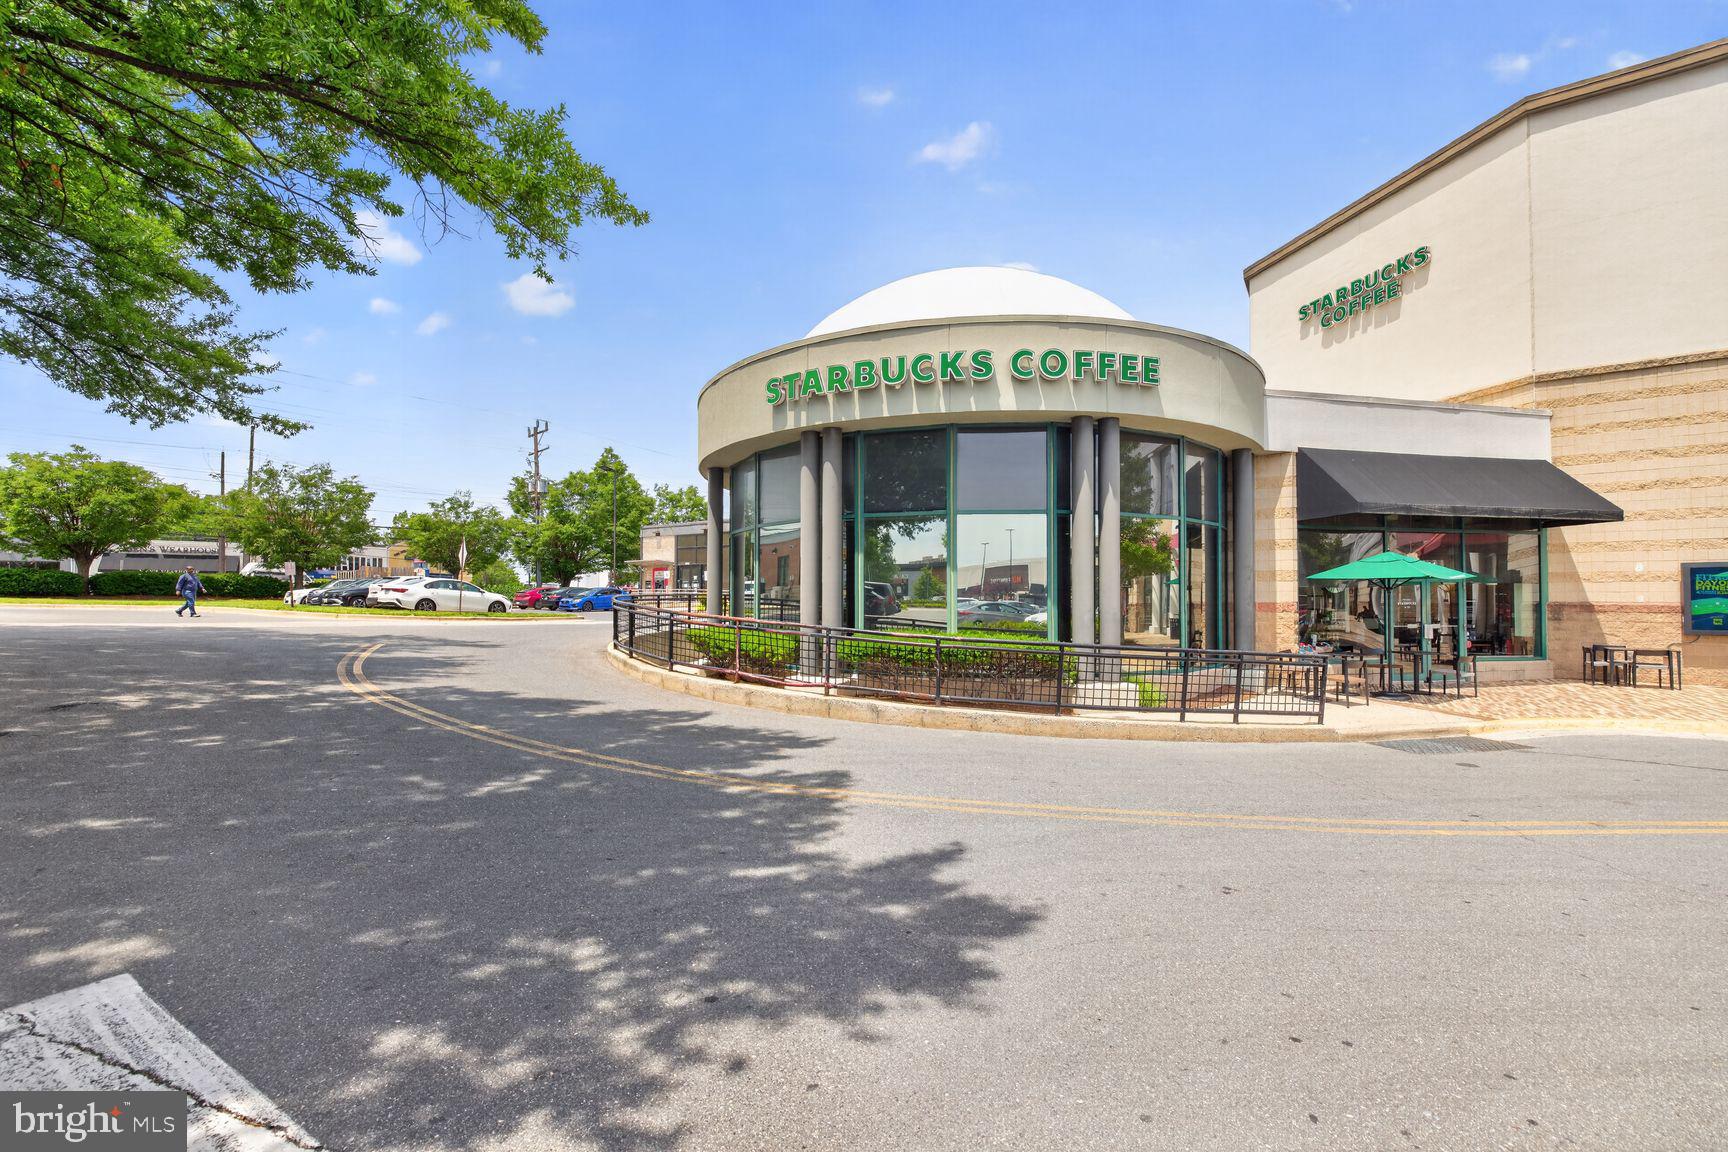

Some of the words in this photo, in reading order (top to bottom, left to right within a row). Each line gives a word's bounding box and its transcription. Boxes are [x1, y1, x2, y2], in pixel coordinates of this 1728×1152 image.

[1298, 245, 1431, 321] STARBUCKS
[1319, 279, 1402, 329] COFFEE
[766, 350, 994, 406] STARBUCKS
[1009, 348, 1161, 386] COFFEE
[159, 545, 219, 554] WEARHOUS
